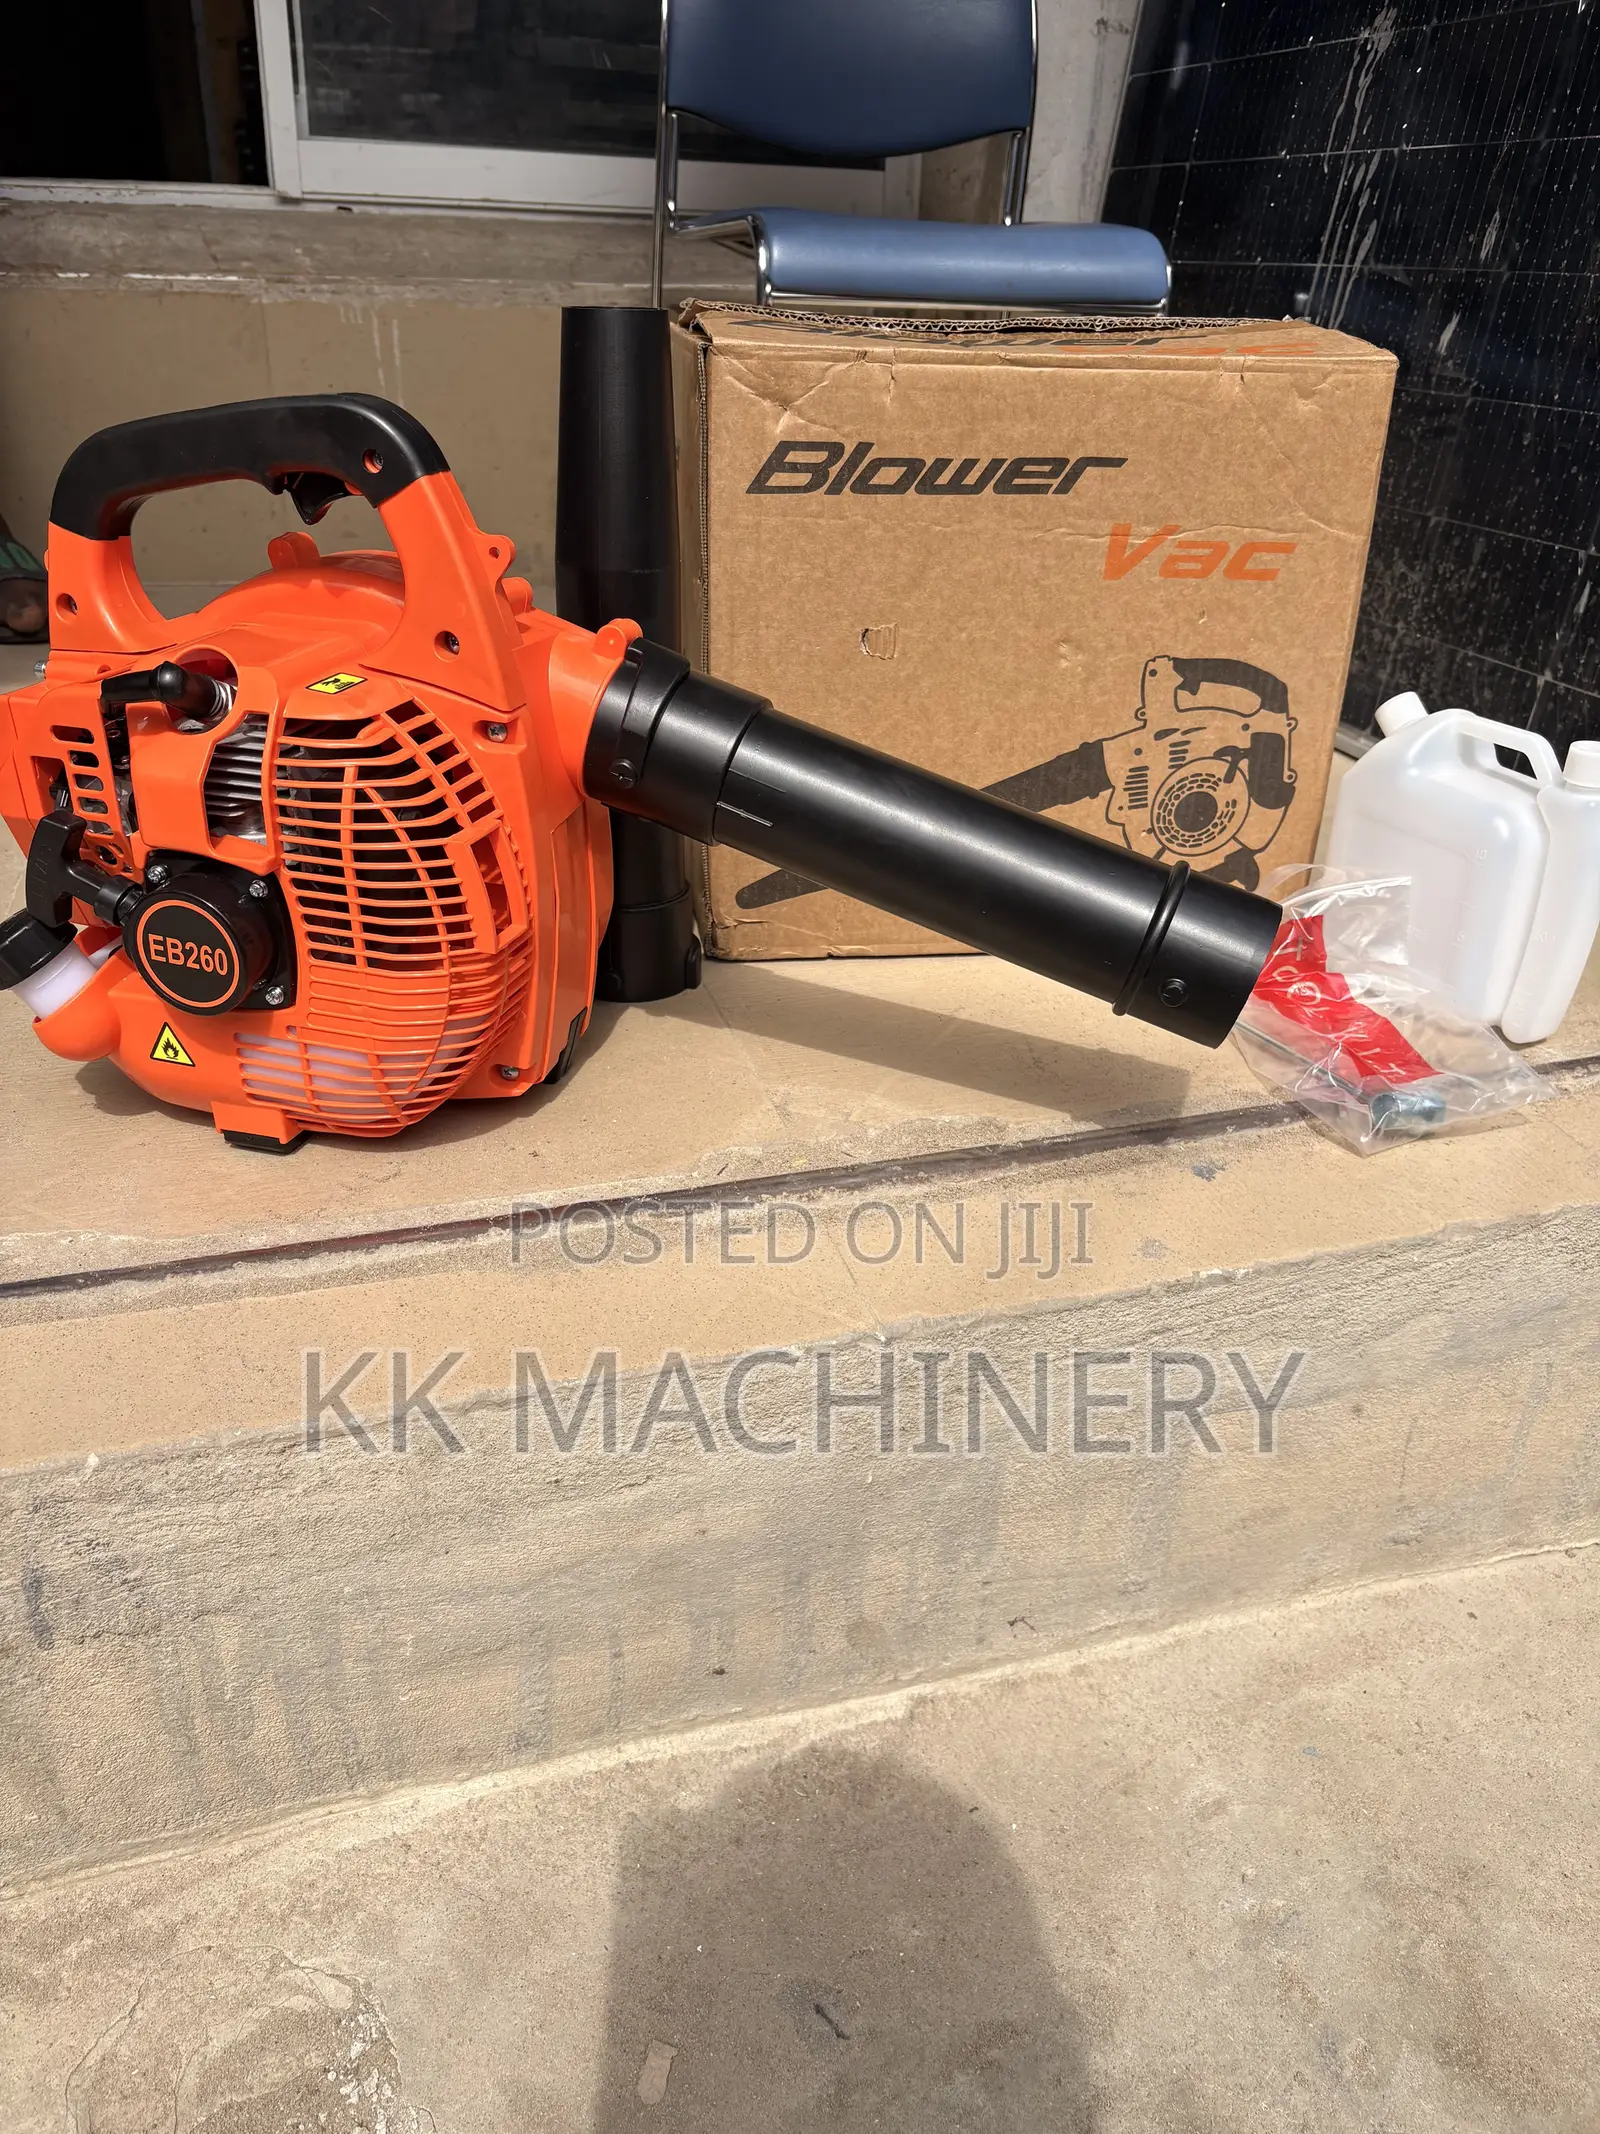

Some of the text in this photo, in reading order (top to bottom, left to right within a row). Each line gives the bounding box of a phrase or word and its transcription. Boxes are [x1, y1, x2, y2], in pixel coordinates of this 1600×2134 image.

[745, 440, 1128, 495] Blower
[1102, 523, 1297, 581] Vac
[148, 933, 228, 976] EB260
